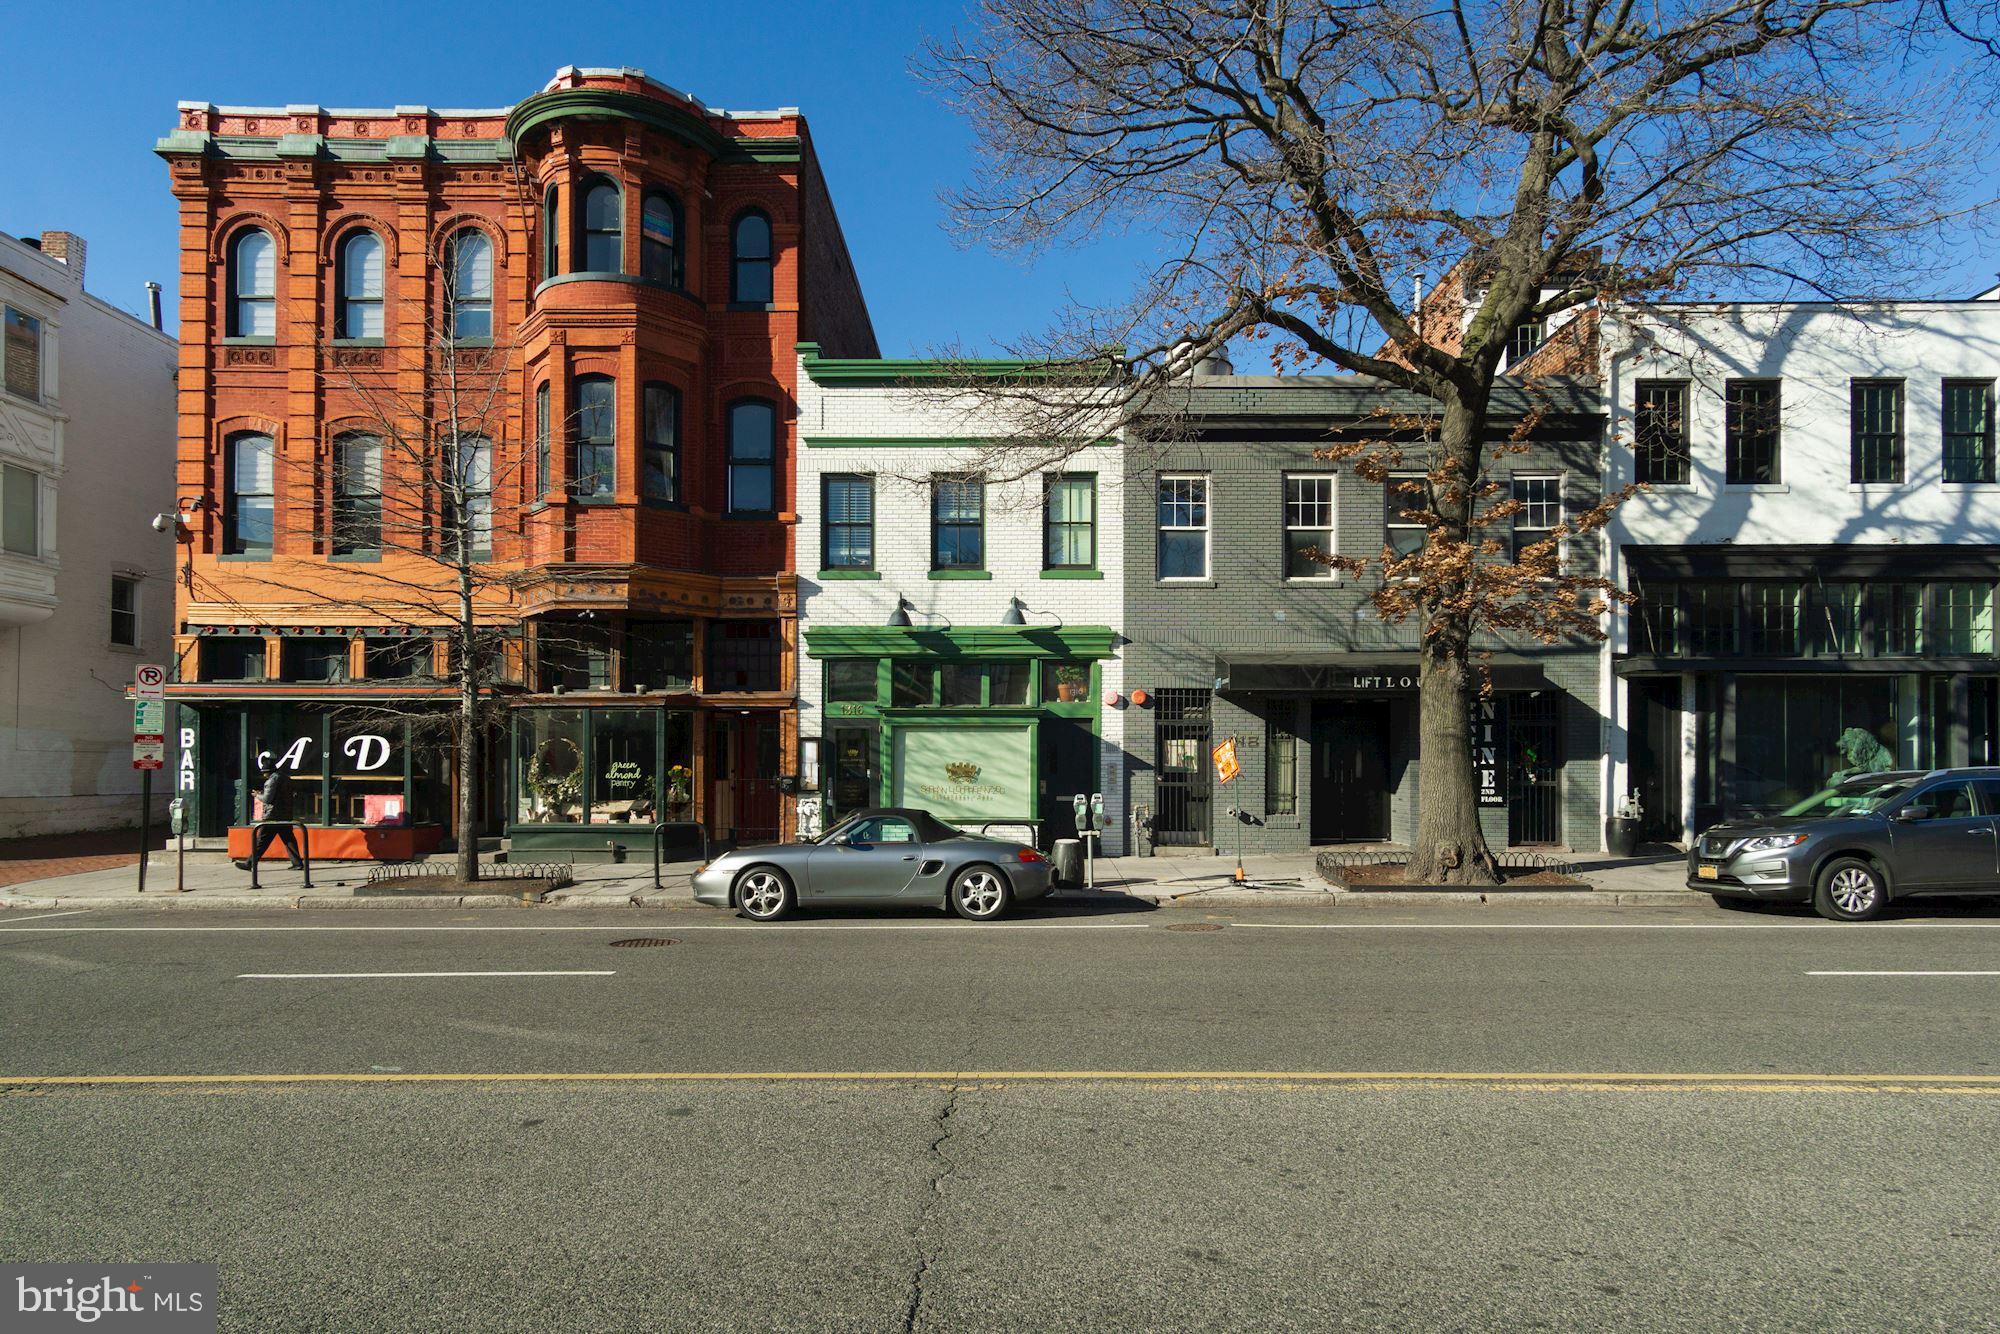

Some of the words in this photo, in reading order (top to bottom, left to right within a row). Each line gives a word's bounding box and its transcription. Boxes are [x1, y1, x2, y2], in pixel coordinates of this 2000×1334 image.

[1353, 676, 1381, 688] LIFT
[1480, 702, 1496, 787] NINE
[180, 728, 195, 790] BAR
[257, 736, 313, 770] A
[343, 735, 391, 771] D
[611, 761, 638, 773] green
[605, 768, 642, 779] almond
[611, 780, 636, 789] pantry
